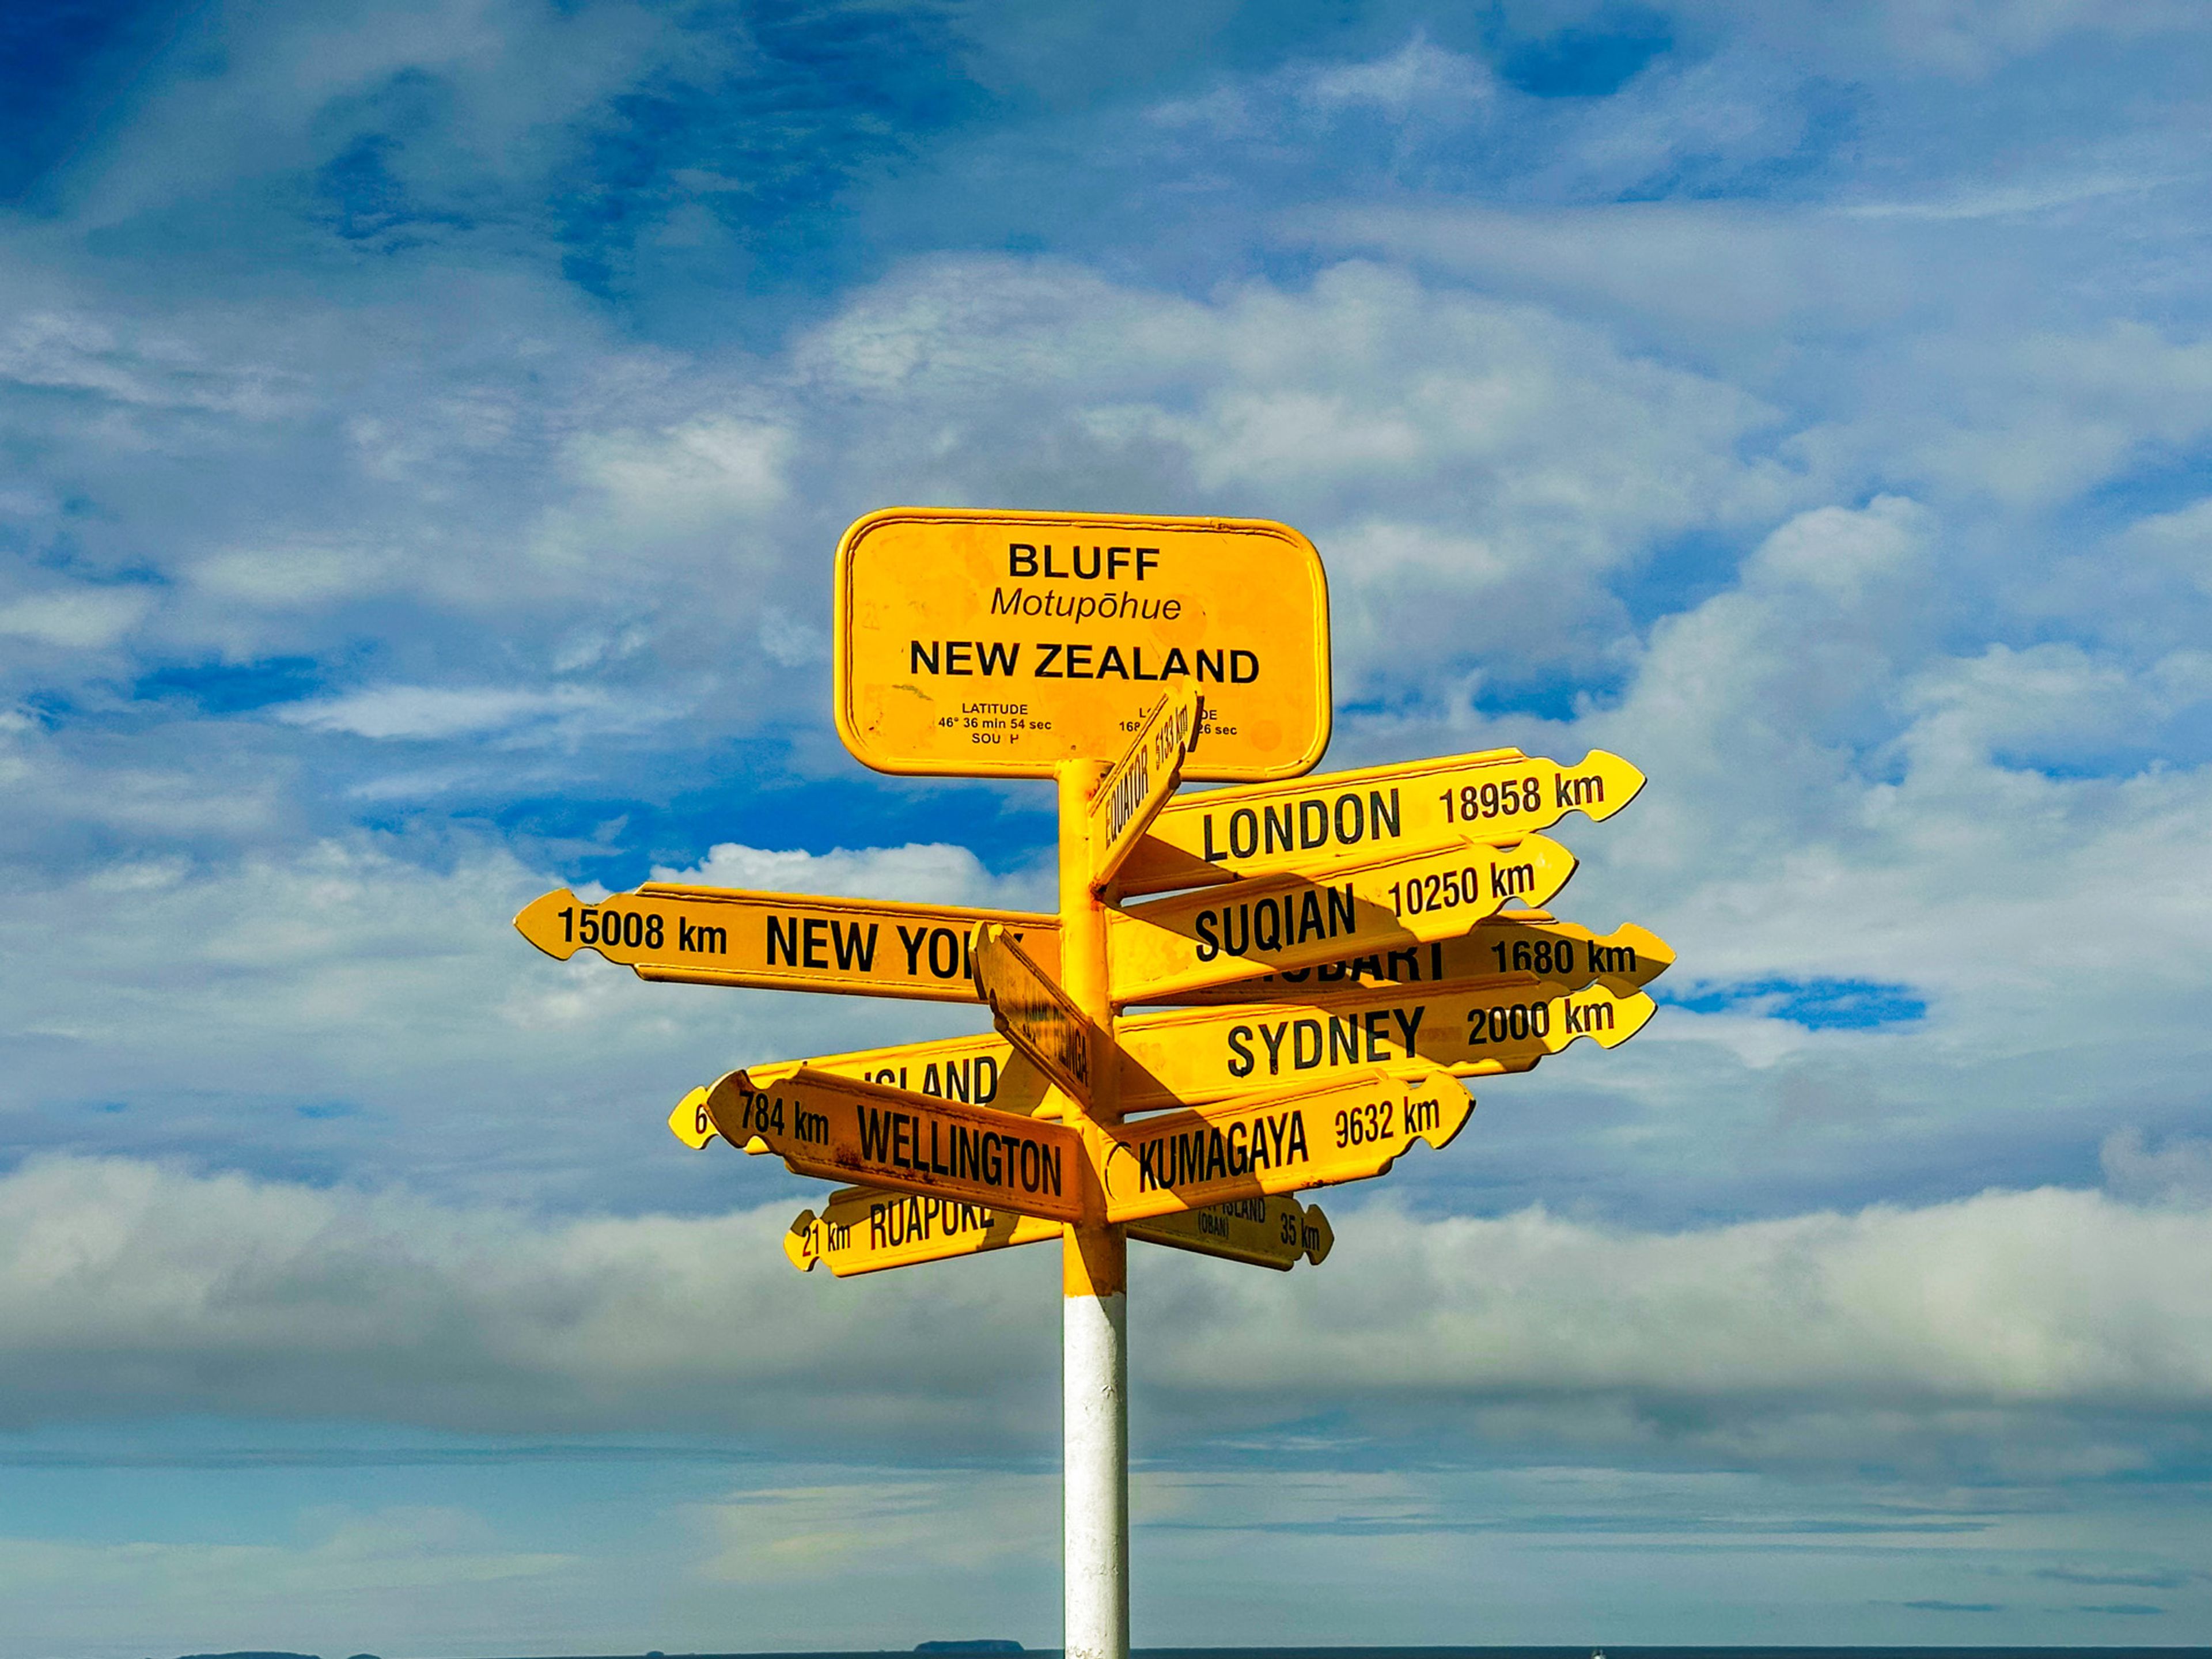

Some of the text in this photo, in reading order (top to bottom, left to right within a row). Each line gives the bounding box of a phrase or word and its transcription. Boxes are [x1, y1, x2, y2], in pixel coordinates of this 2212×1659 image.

[1009, 543, 1160, 581] BLUFF
[991, 587, 1181, 624] Motupōhue
[911, 640, 1260, 684] NEW ZEALAND
[962, 703, 1028, 715] LATITUDE
[964, 718, 978, 728] 36
[982, 718, 1006, 729] min
[1011, 718, 1025, 729] 54
[1029, 722, 1052, 730] sec
[1215, 726, 1237, 735] sec
[1105, 744, 1149, 851] EQUATOR
[1203, 772, 1604, 863] LONDON 18958 km
[1195, 860, 1535, 963] SUQIAN 10250 km
[557, 906, 1024, 979] 15008 km NEW YO
[1490, 940, 1574, 975] 1680
[1586, 939, 1637, 974] km
[1228, 998, 1615, 1079] SYDNEY 2000 km
[738, 1090, 1062, 1198] 784 km WELLINGTON
[1138, 1097, 1440, 1194] KUMAGAYA 9632 km
[802, 1222, 819, 1257] 21
[828, 1221, 851, 1252] km
[1198, 1210, 1229, 1240] (OBAN)
[1280, 1211, 1296, 1247] 35
[1301, 1217, 1320, 1252] km
